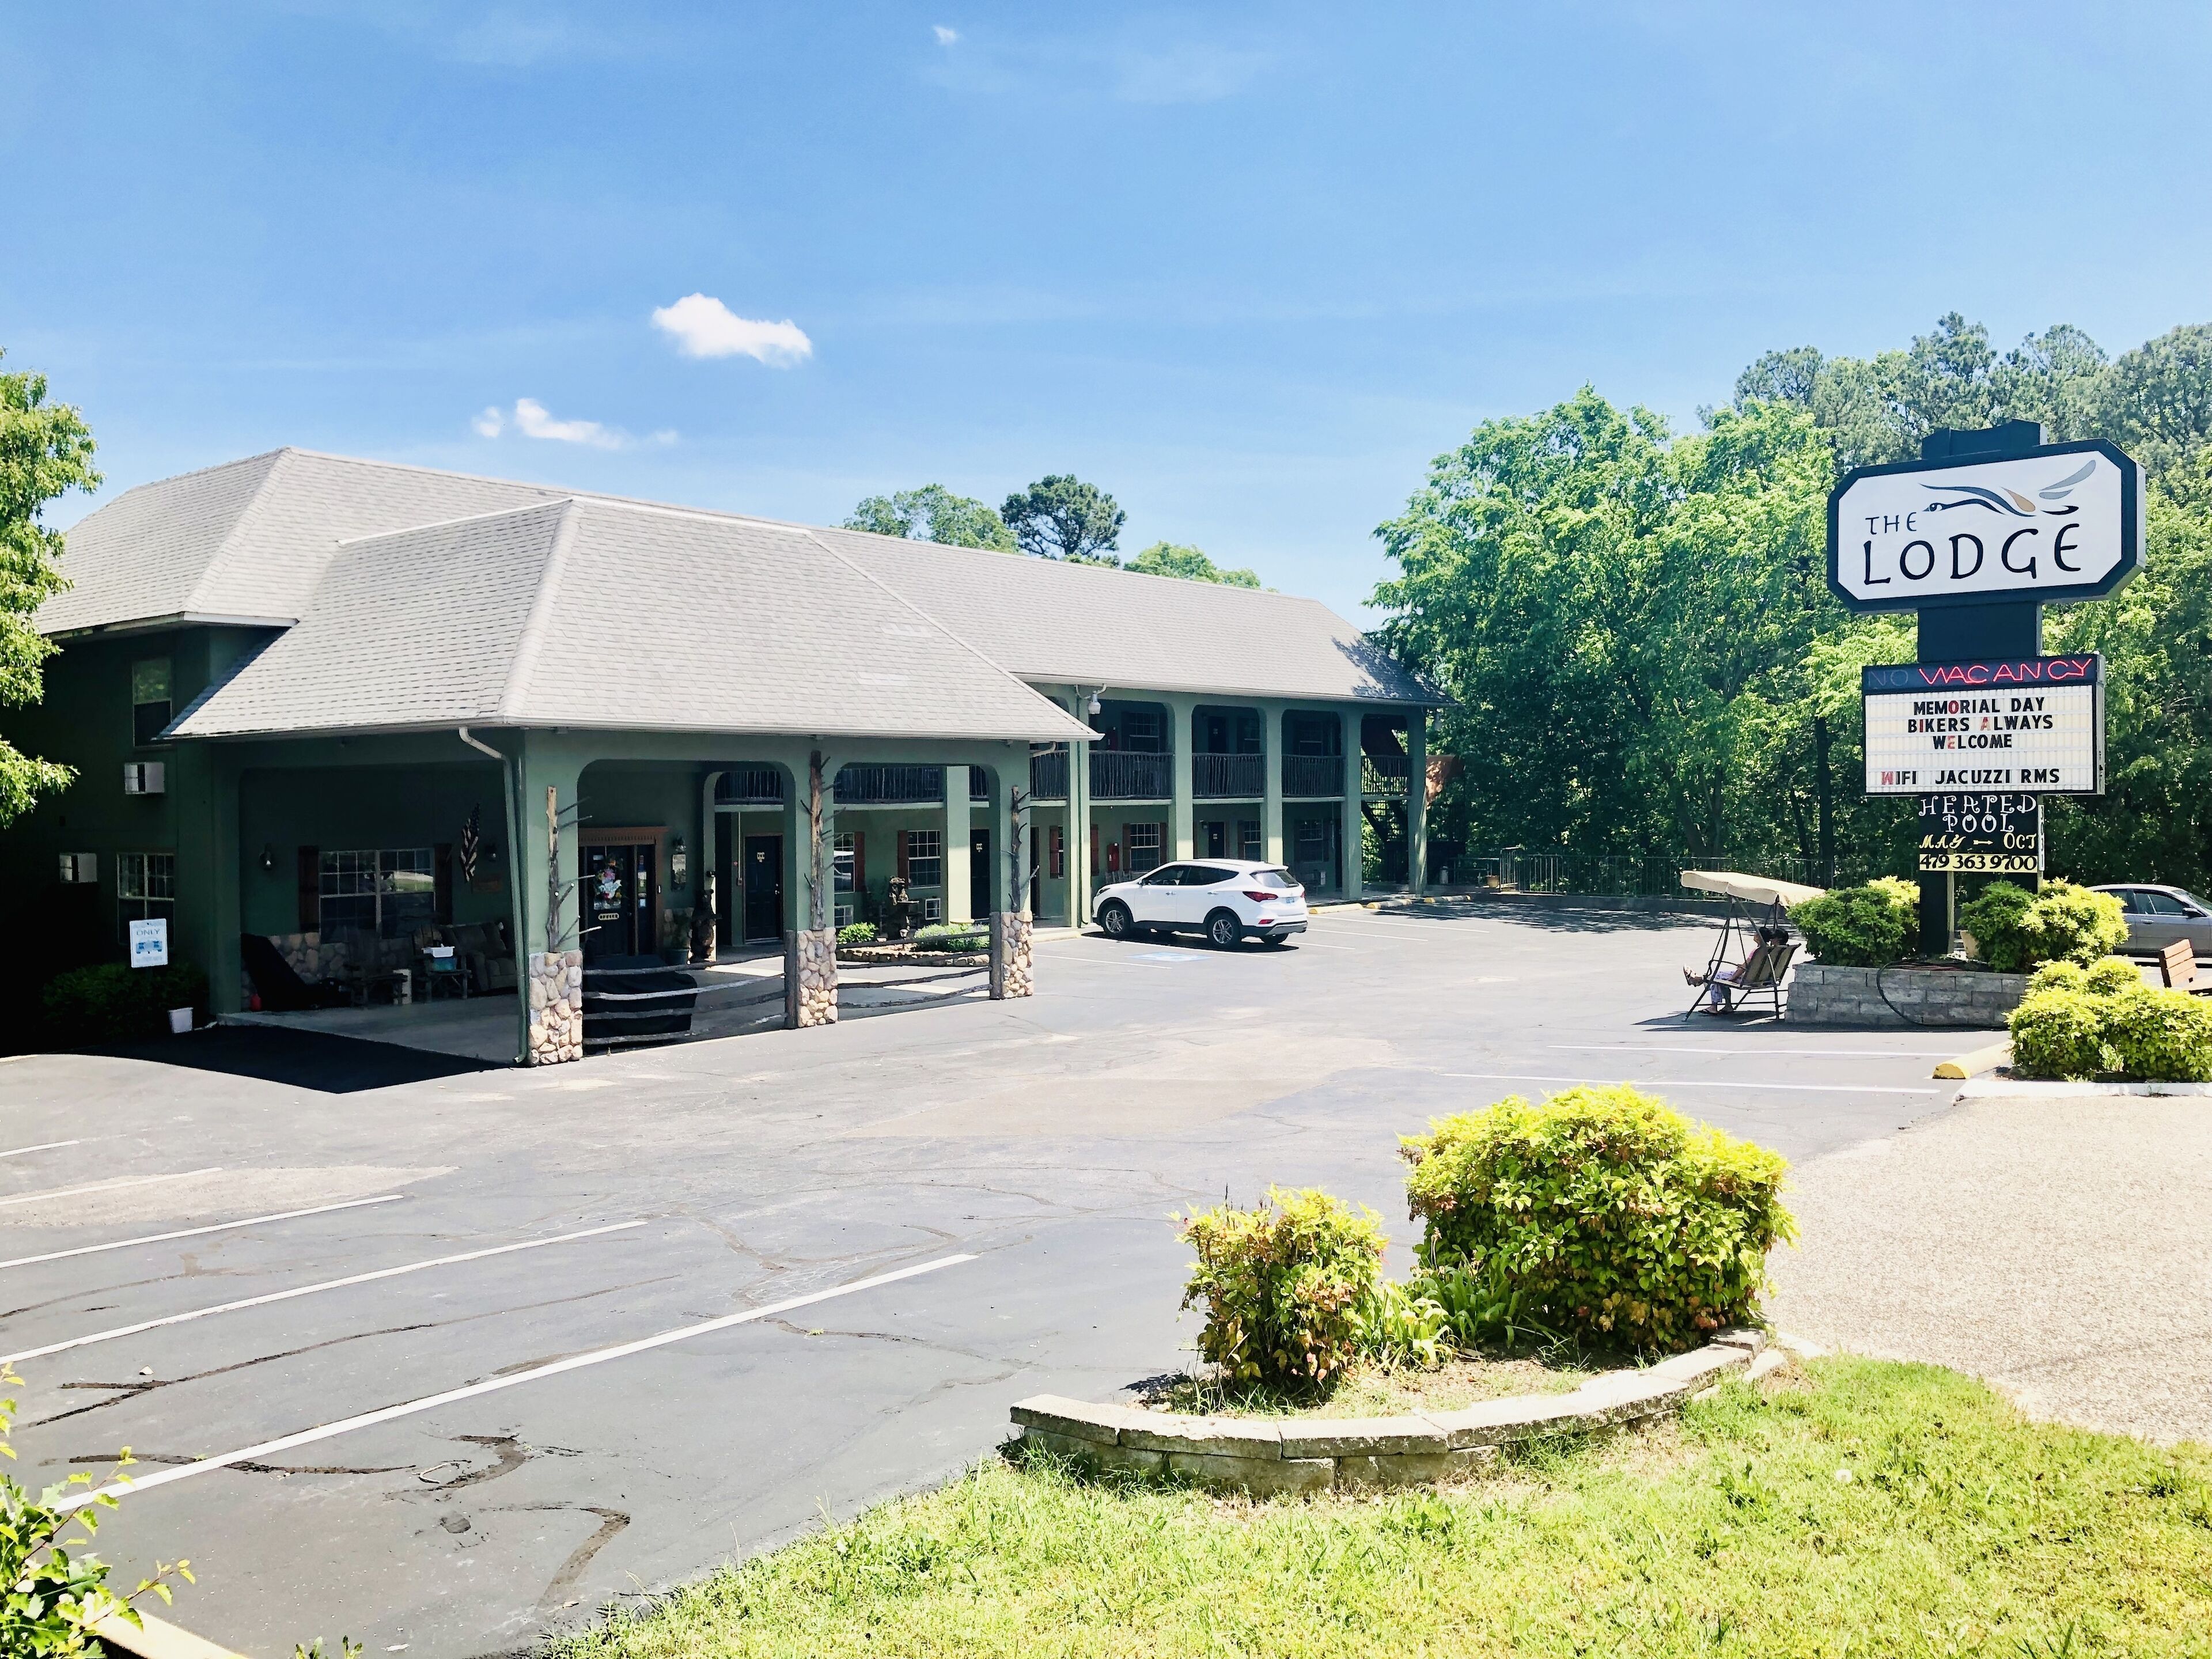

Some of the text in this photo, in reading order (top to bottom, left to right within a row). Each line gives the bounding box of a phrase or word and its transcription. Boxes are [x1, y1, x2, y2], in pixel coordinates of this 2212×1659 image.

[1865, 512, 1917, 535] THE
[1863, 524, 2081, 585] LODGE
[1868, 658, 2092, 687] NO VACANCY
[1914, 697, 2044, 715] MEMORIAL DAY
[1908, 715, 2053, 733] BIKERS ALWAYS
[1933, 734, 2012, 749] WELCOME
[1881, 768, 2060, 785] WIFI JACUZZI RMS
[1918, 794, 2036, 816] HEATED
[1942, 812, 2014, 832] POOL
[1921, 855, 2037, 870] 479 363 9700
